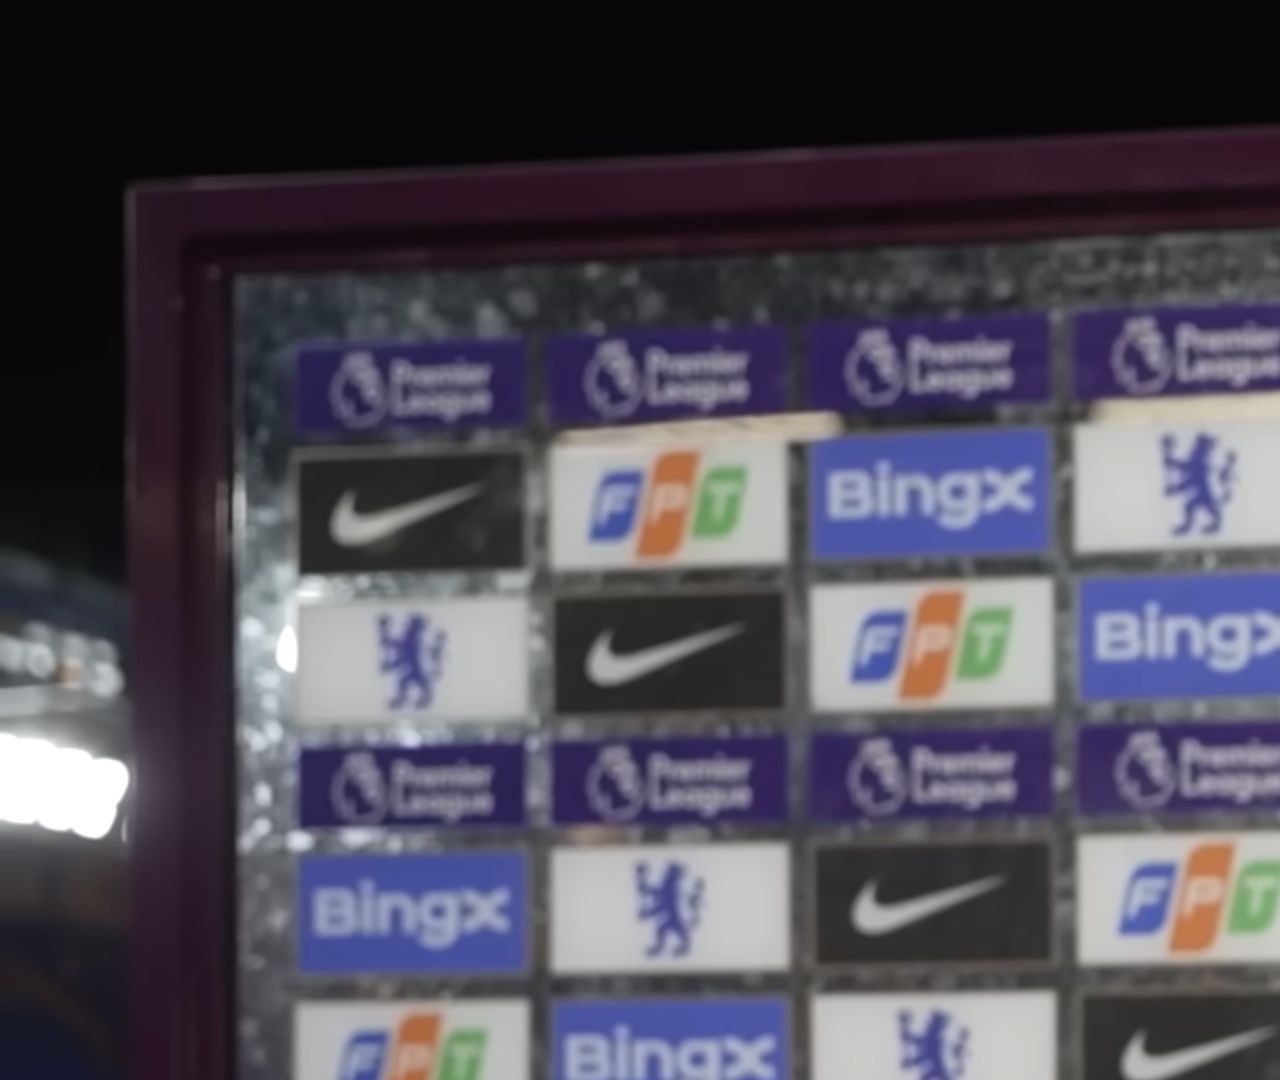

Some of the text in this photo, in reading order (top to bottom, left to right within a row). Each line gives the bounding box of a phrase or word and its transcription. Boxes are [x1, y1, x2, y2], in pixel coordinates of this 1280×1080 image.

[645, 344, 747, 379] Premier
[907, 332, 1011, 368] Premier
[390, 355, 490, 391] Premier
[907, 364, 1014, 401] League
[390, 387, 492, 422] League
[645, 375, 749, 411] League
[391, 758, 492, 791] Premier
[648, 751, 750, 784] Premier
[911, 744, 1015, 778] Premier
[391, 789, 493, 825] League
[648, 782, 752, 818] League
[911, 776, 1017, 810] League
